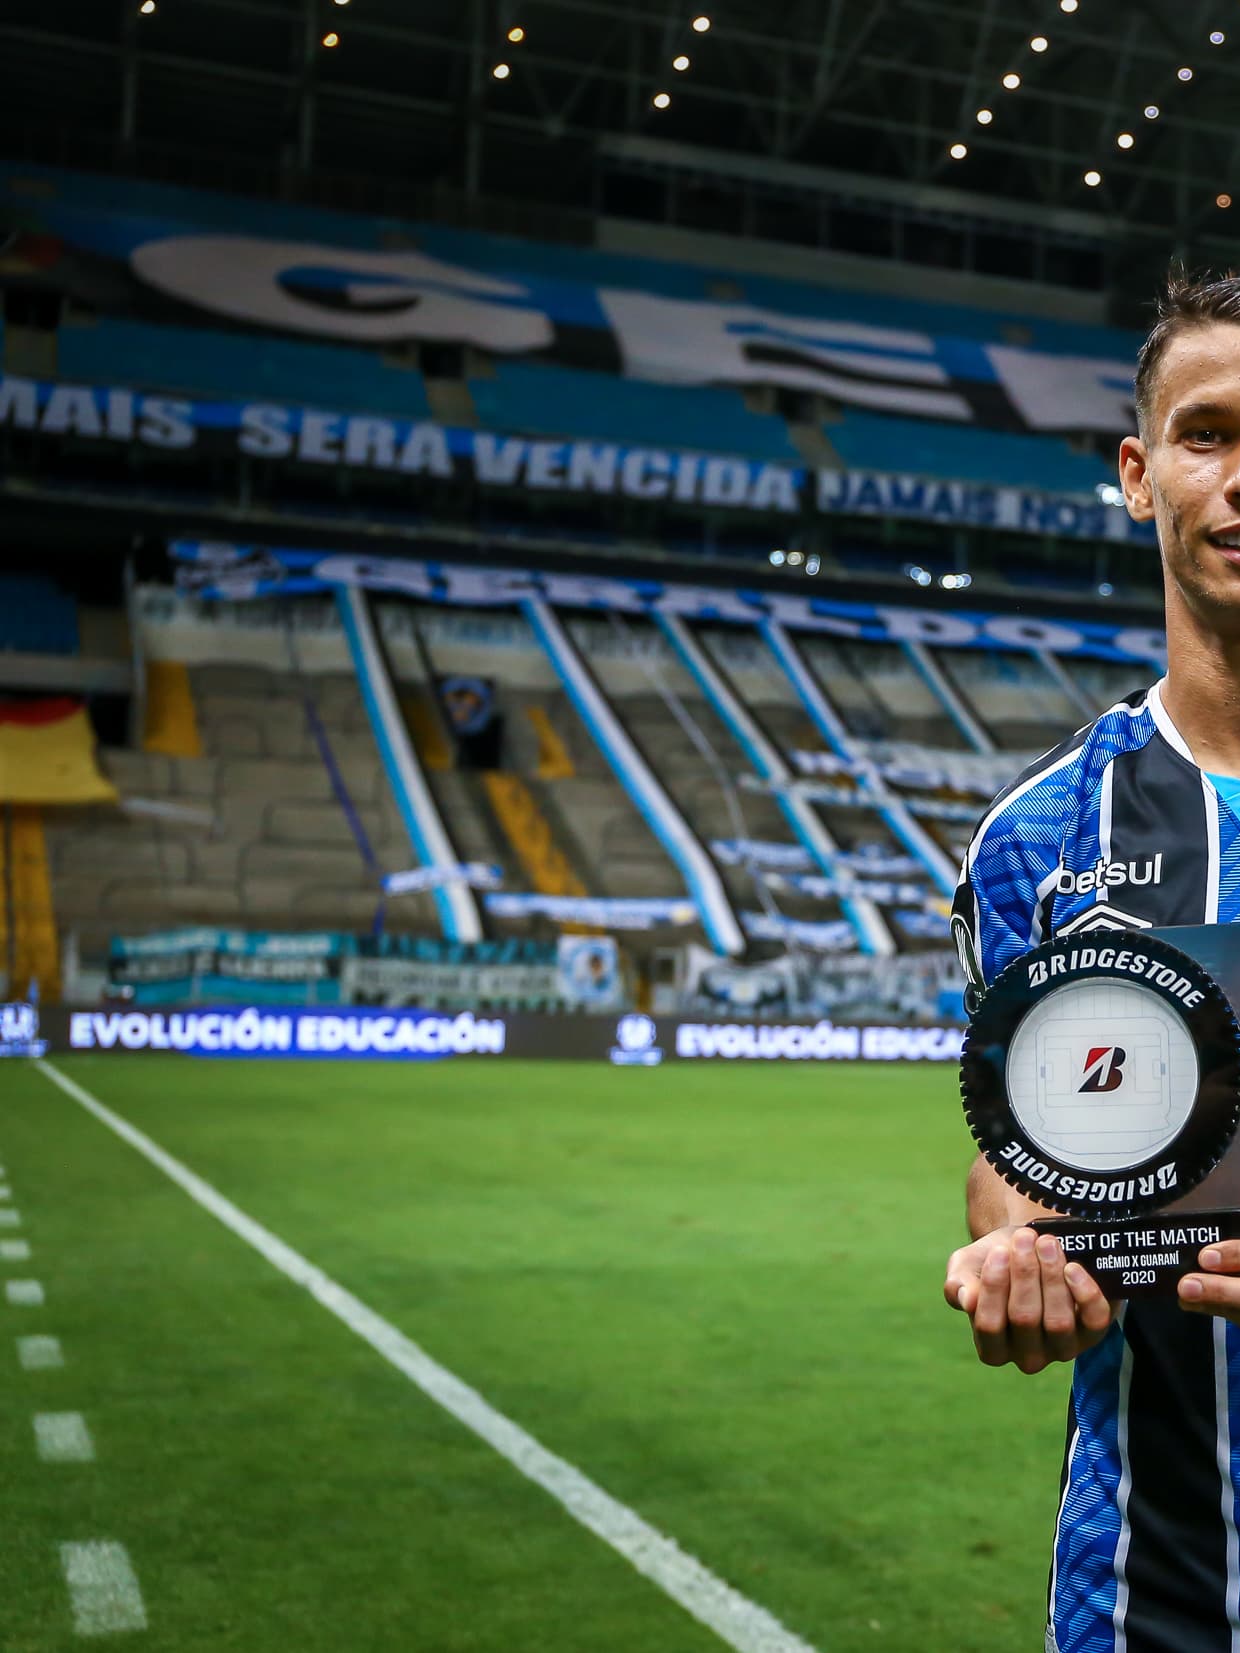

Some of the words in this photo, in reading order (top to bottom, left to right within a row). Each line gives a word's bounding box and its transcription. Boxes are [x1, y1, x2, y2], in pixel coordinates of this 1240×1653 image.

[238, 402, 454, 478] SERA
[471, 431, 798, 511] VENCIDA
[1057, 853, 1162, 895] betsul
[1028, 948, 1205, 1008] BRIDGESTONE
[70, 1007, 292, 1051] EVOLUCIÓN
[299, 1012, 506, 1055] EDUCACIÓN
[676, 1020, 860, 1060] EVOLUCIÓN
[999, 1141, 1177, 1202] BRIDGESTONE
[1099, 1232, 1120, 1249] OF
[1124, 1230, 1156, 1248] THE
[1160, 1226, 1220, 1245] MATCH
[1096, 1253, 1130, 1270] GRÊMIO
[1132, 1256, 1139, 1268] X
[1140, 1250, 1180, 1267] GUARANÍ
[1122, 1269, 1156, 1285] 2020
